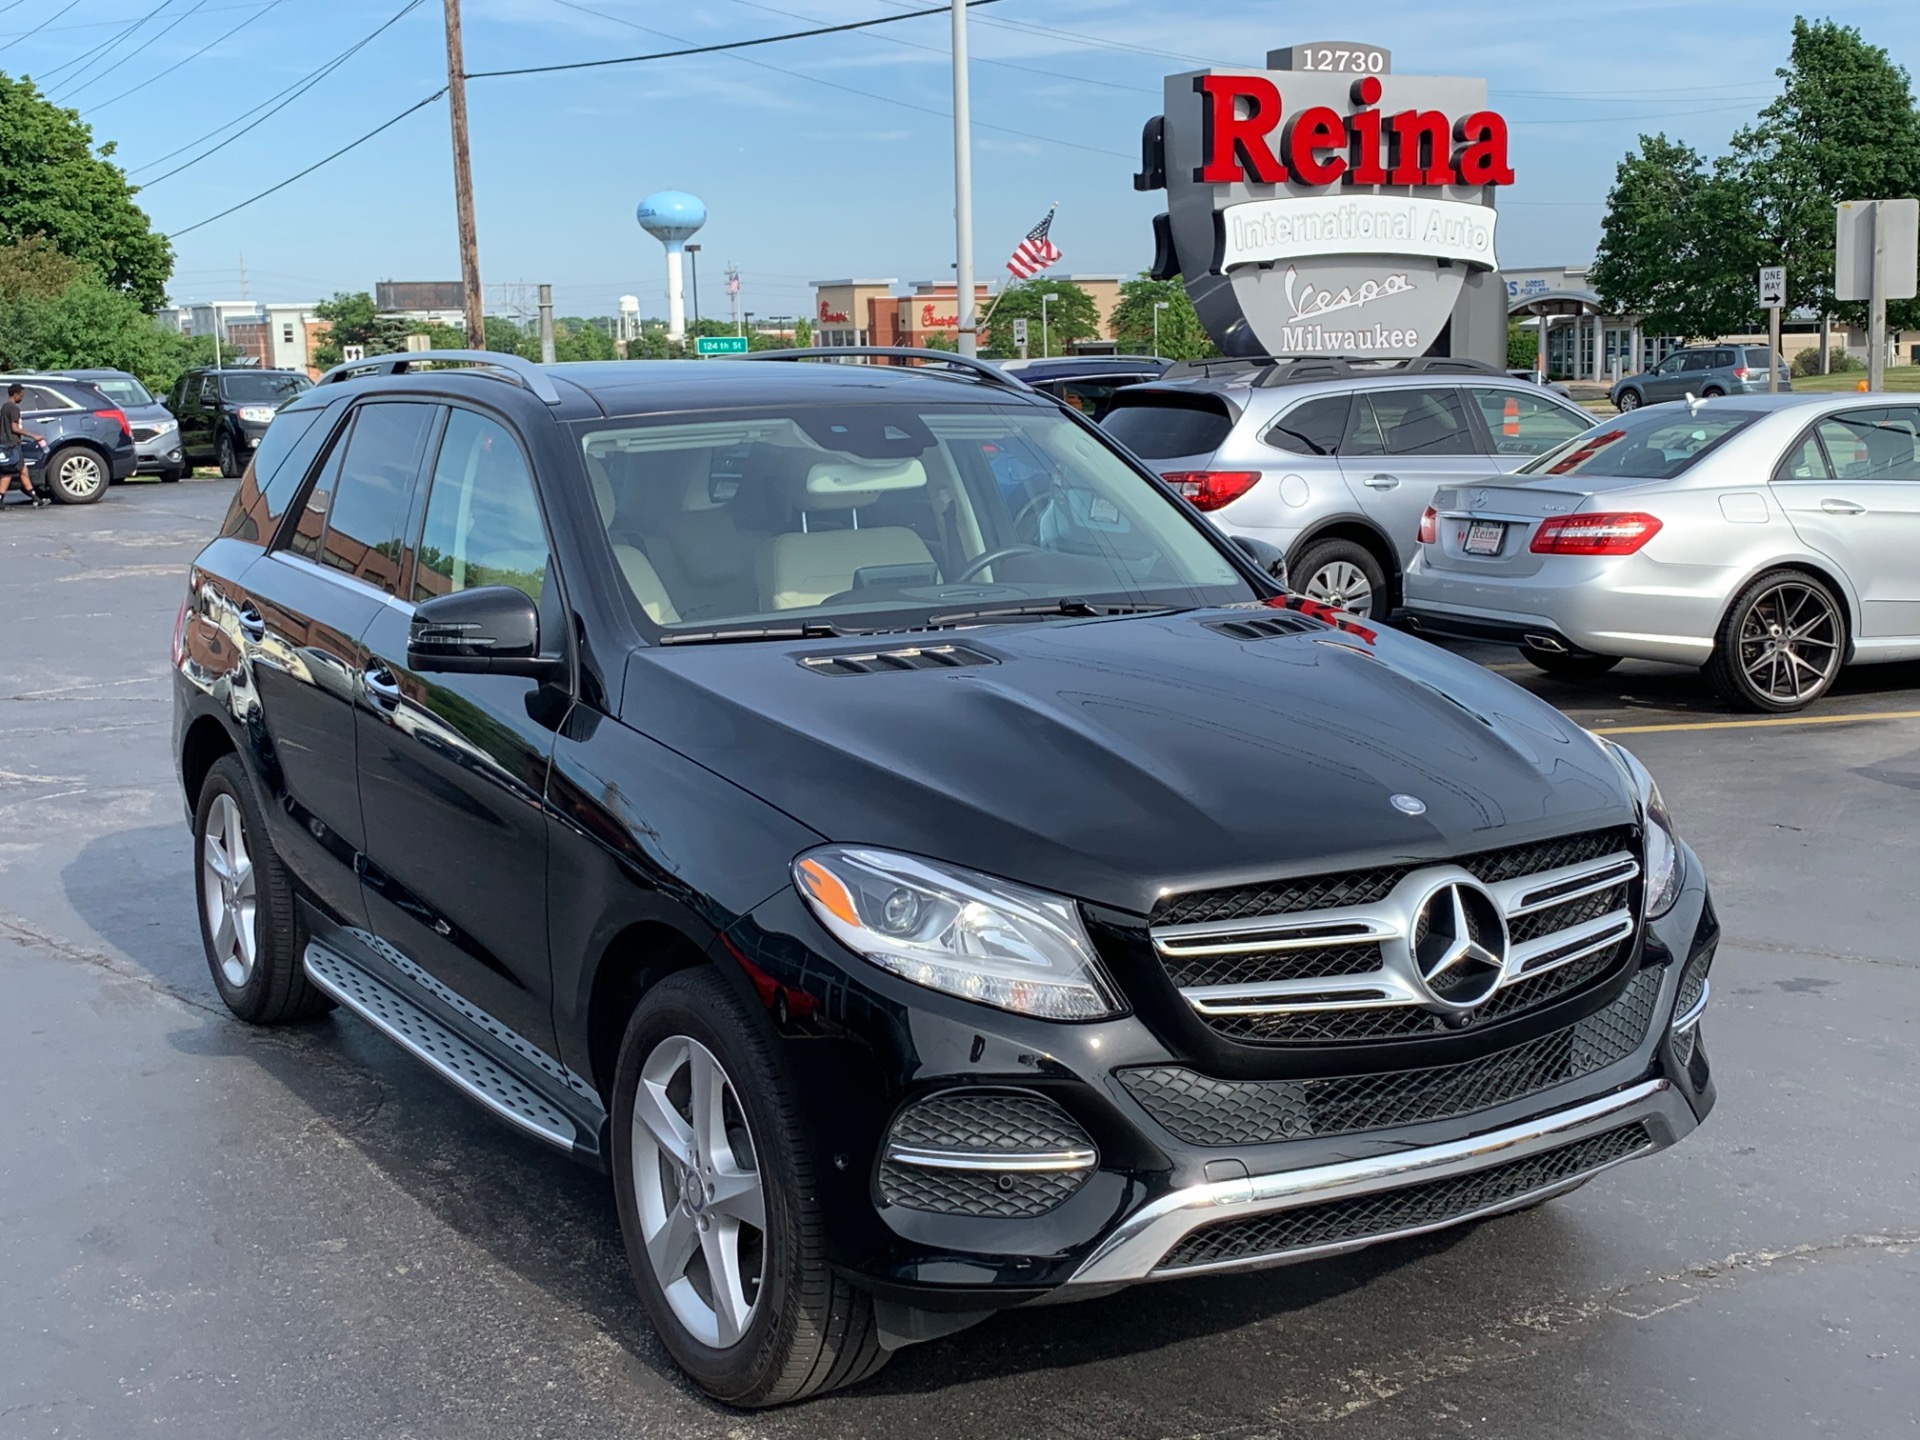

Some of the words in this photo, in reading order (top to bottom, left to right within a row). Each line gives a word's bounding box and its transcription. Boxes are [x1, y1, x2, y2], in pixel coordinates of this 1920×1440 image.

[1302, 49, 1384, 72] 12730
[1194, 75, 1515, 186] Reina
[1233, 206, 1417, 250] International
[1423, 209, 1489, 251] Auto
[1764, 270, 1781, 280] ONE
[1764, 281, 1781, 291] WAY
[1284, 264, 1417, 323] Vespa
[703, 342, 718, 350] 124
[720, 342, 729, 350] th
[732, 341, 742, 350] St
[1281, 323, 1418, 352] Milwaukee
[1471, 527, 1499, 540] Reina
